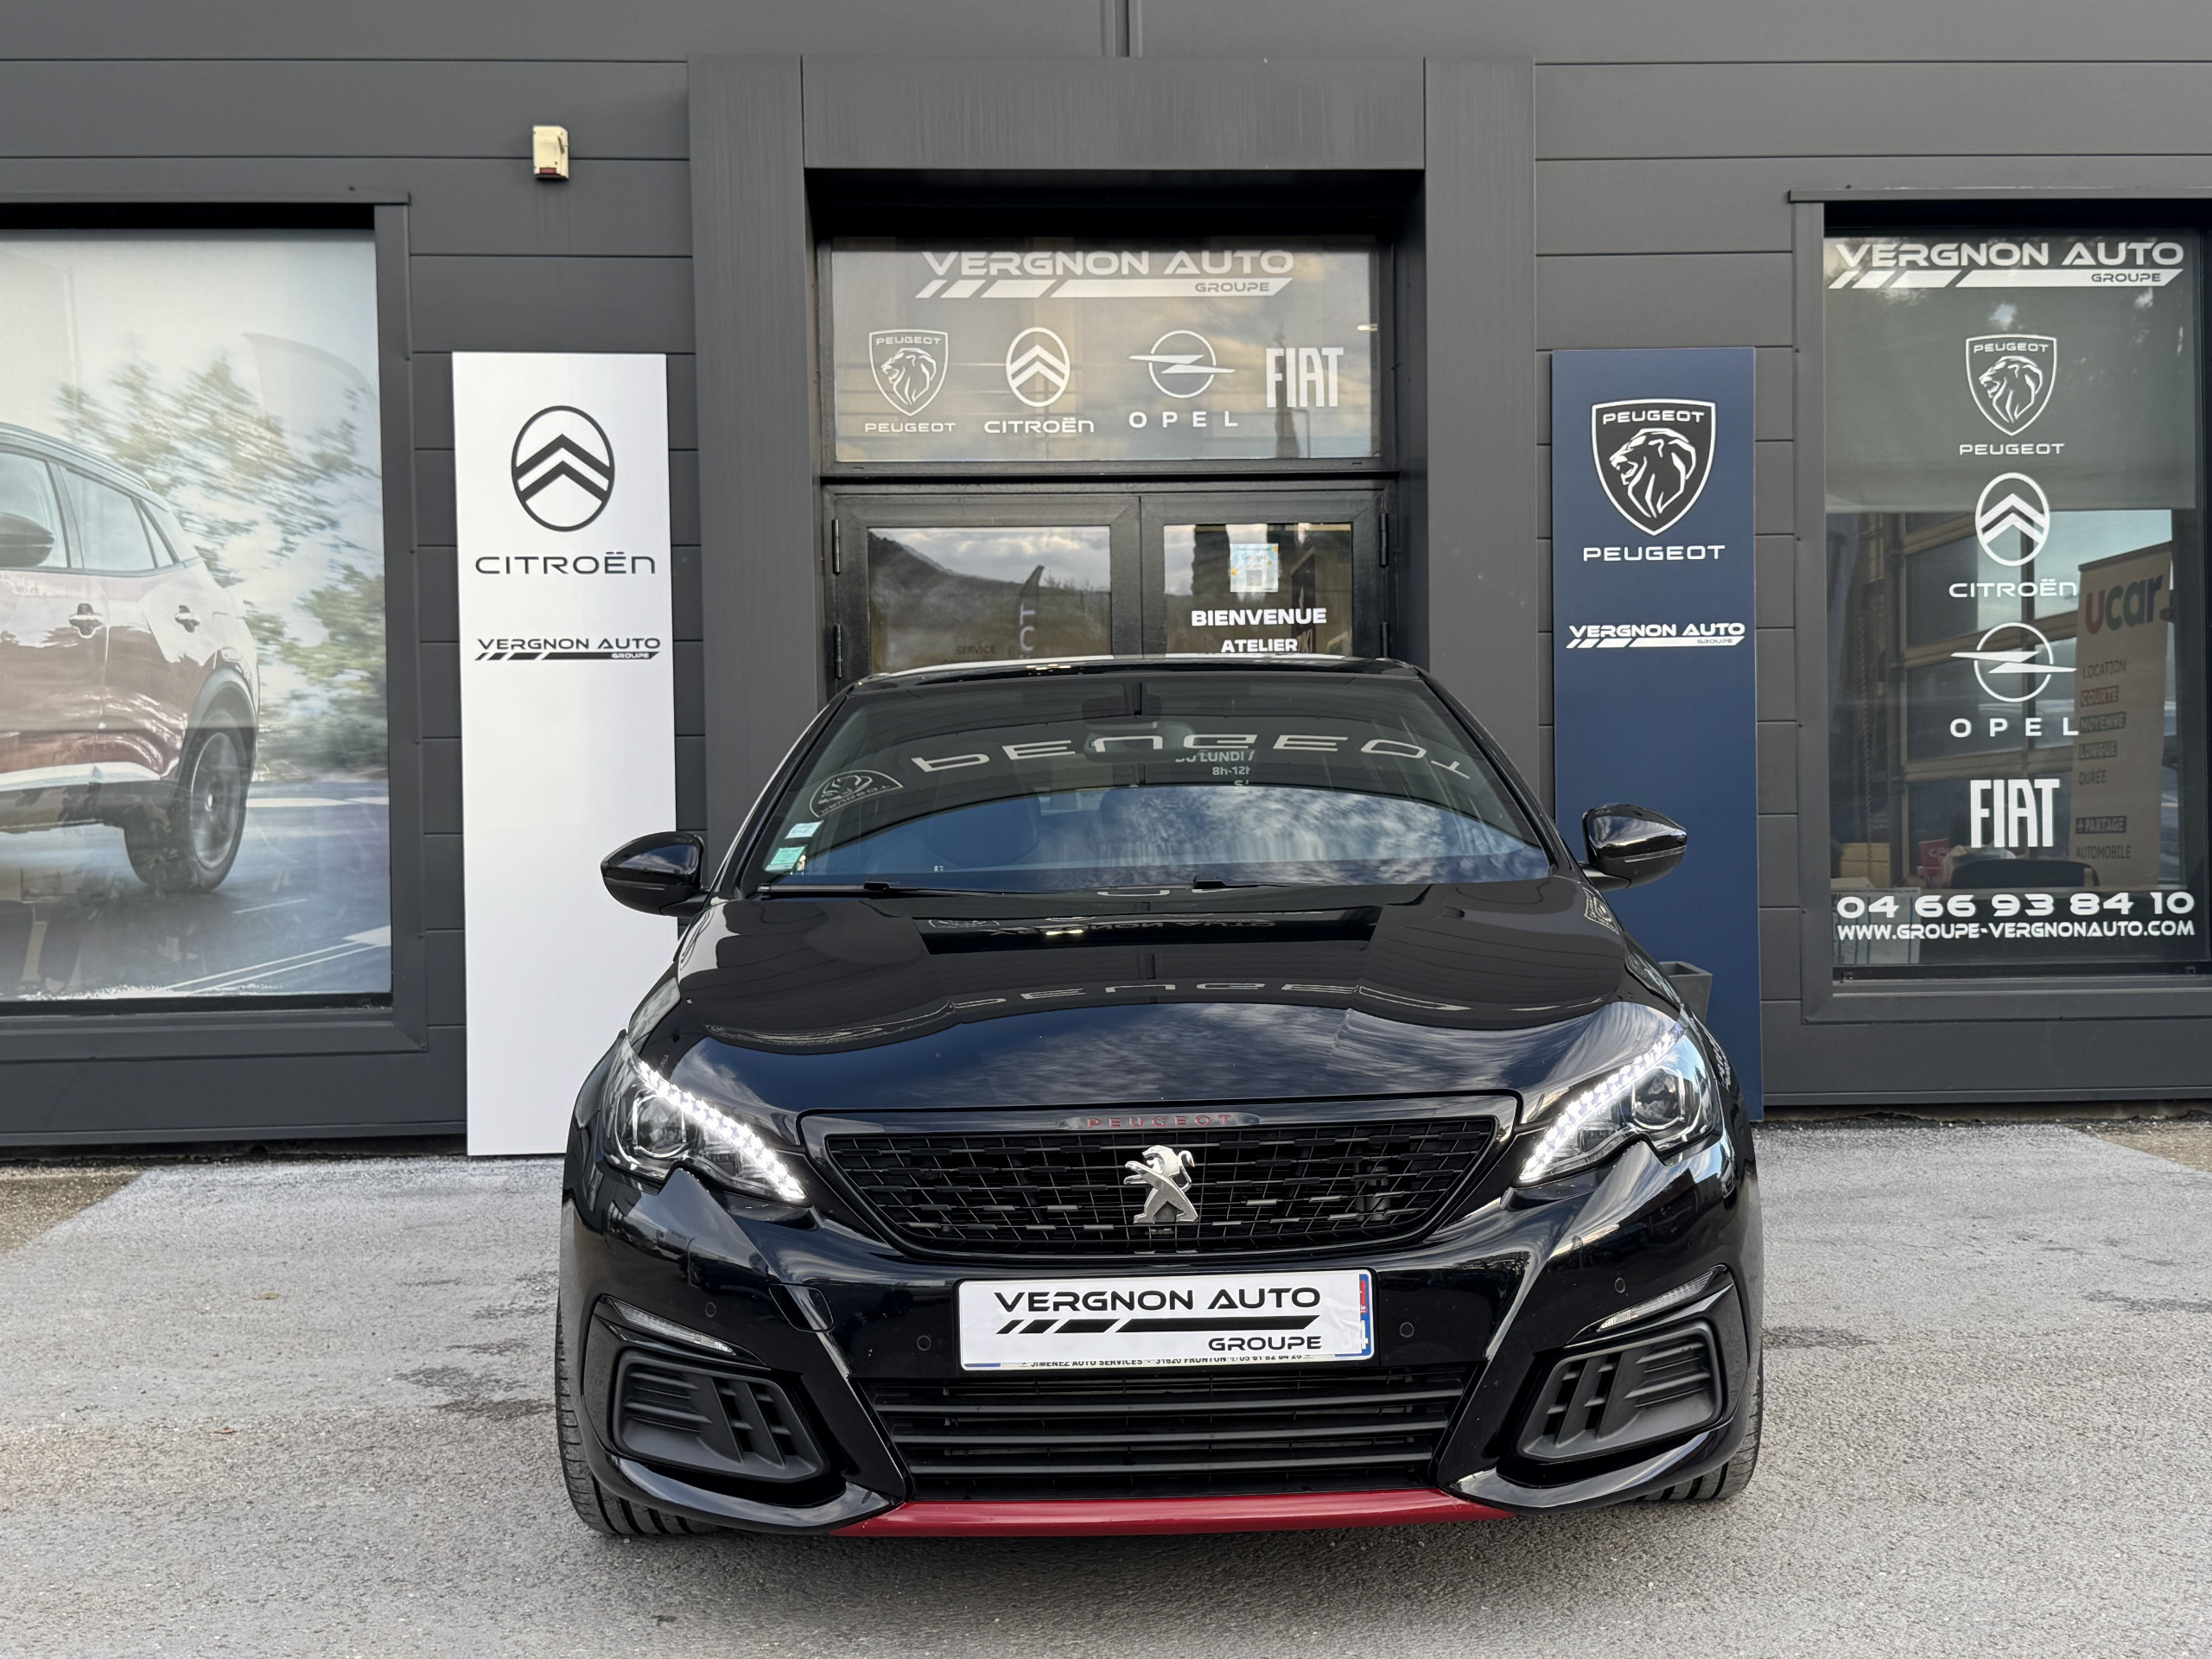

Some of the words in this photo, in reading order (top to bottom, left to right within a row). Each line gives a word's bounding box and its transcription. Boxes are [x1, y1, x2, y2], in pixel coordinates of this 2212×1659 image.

[922, 251, 1150, 276] VERGNON
[1164, 249, 1295, 275] AUTO
[1834, 243, 2050, 267] VERGNON
[2061, 242, 2184, 266] AUTO
[2090, 272, 2163, 283] GROUPE
[1194, 281, 1271, 294] GROUPE
[875, 335, 942, 347] PEUGEOT
[1973, 341, 2050, 354] PEUGEOT
[1266, 346, 1344, 408] FIAT
[1128, 410, 1239, 428] OPEL
[1602, 410, 1706, 425] PEUGEOT
[864, 421, 957, 434] PEUGEOT
[1959, 442, 2066, 456] PEUGEOT
[1583, 545, 1726, 562] PEUGEOT
[1191, 607, 1327, 626] BIENVENUE
[1568, 624, 1677, 639] VERGNON
[1681, 622, 1745, 637] AUTO
[477, 638, 590, 651] VERGNON
[597, 637, 661, 650] AUTO
[1220, 638, 1298, 653] ATELIER
[2082, 659, 2127, 679] LOCATION
[2081, 689, 2118, 706] COURTE
[1949, 717, 2079, 738] OPEL
[1199, 751, 1244, 762] LUNDI
[1969, 778, 2060, 848] FIAT
[2075, 845, 2132, 860] AUTOMOBILE
[1837, 895, 1899, 919] 04
[1915, 893, 1976, 918] 66
[1991, 893, 2054, 917] 93
[2069, 893, 2134, 916] 84
[2152, 891, 2196, 914] 10
[1837, 920, 2196, 941] WWW.GROUPE-VERGNONAUTO.COM
[1087, 1114, 1232, 1128] PEUGEOT
[994, 1289, 1194, 1313] VERGNON
[1207, 1287, 1321, 1310] AUTO
[1208, 1336, 1322, 1351] GROUPE
